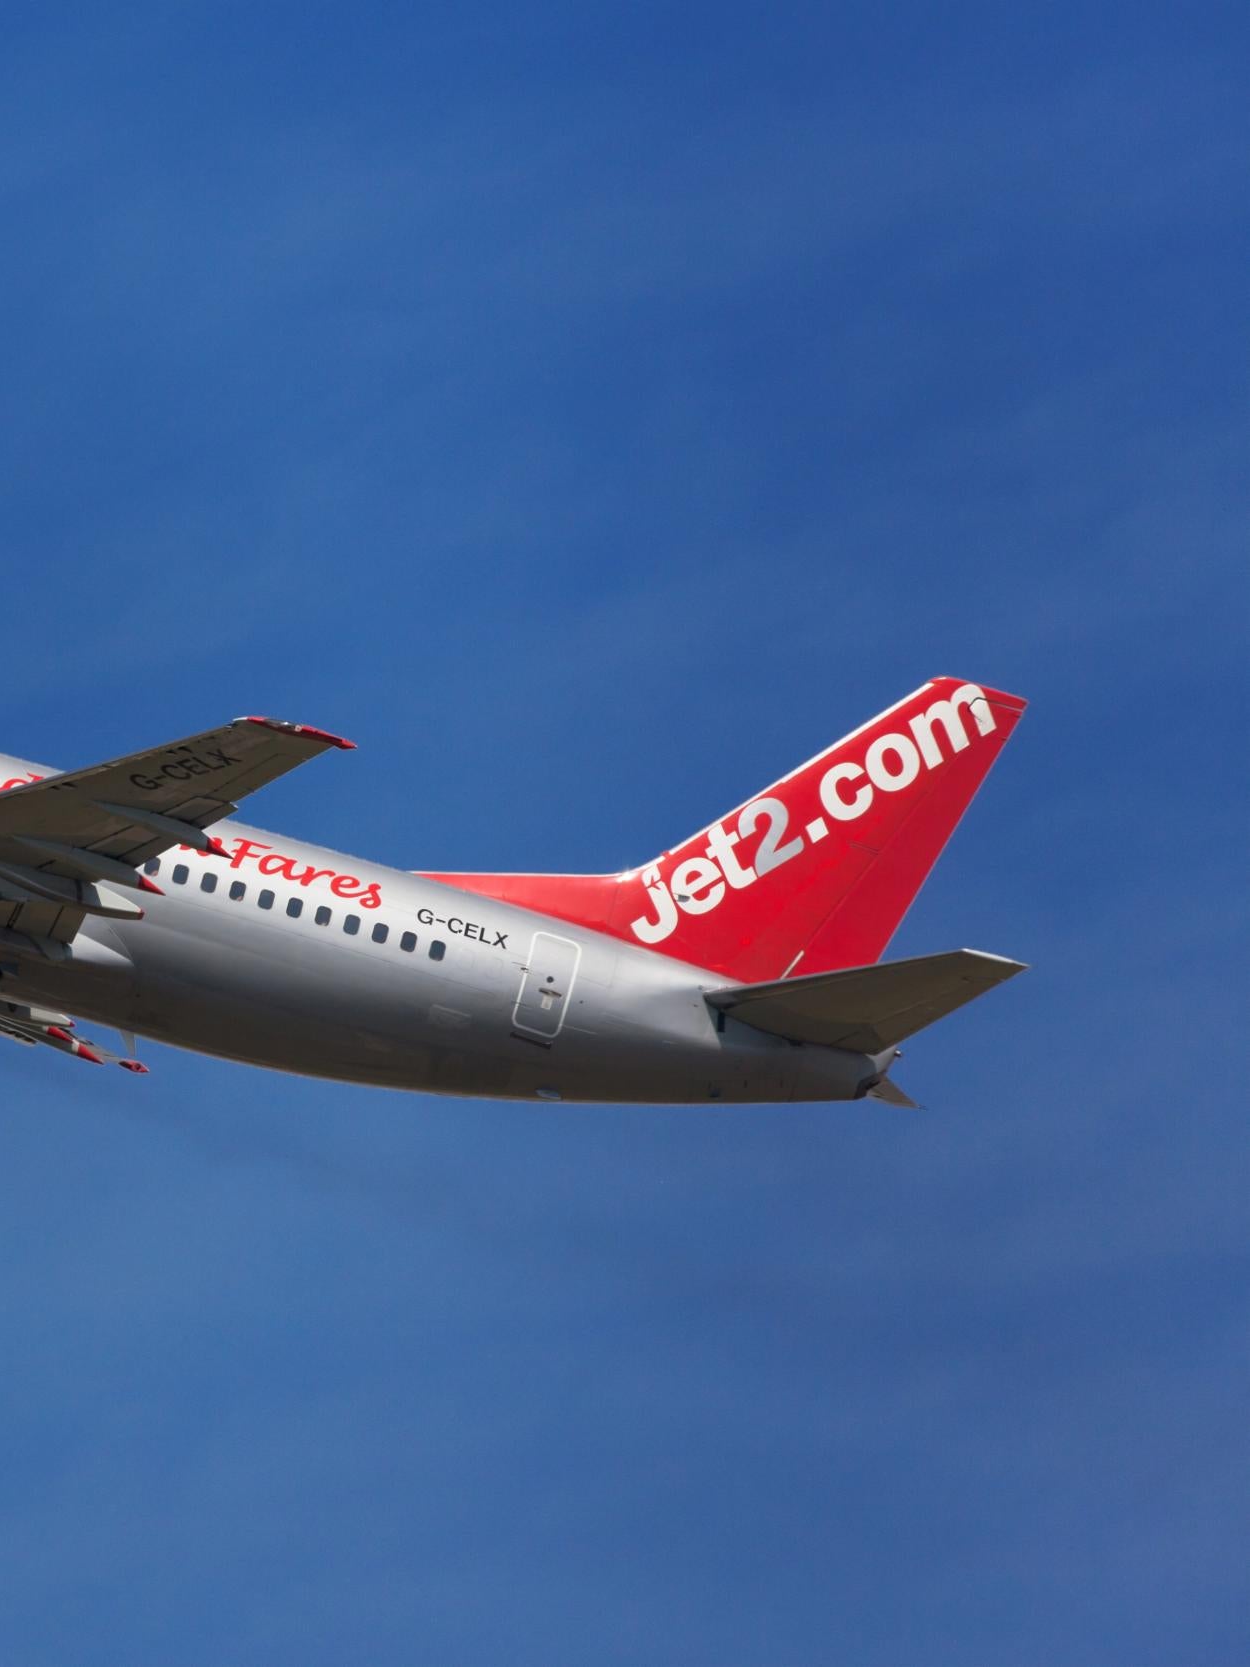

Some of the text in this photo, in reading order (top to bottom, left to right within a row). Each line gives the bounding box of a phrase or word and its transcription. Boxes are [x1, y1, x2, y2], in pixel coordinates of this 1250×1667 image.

[129, 748, 242, 791] G-CELX
[230, 837, 382, 909] Fares
[417, 908, 509, 949] G-CELX
